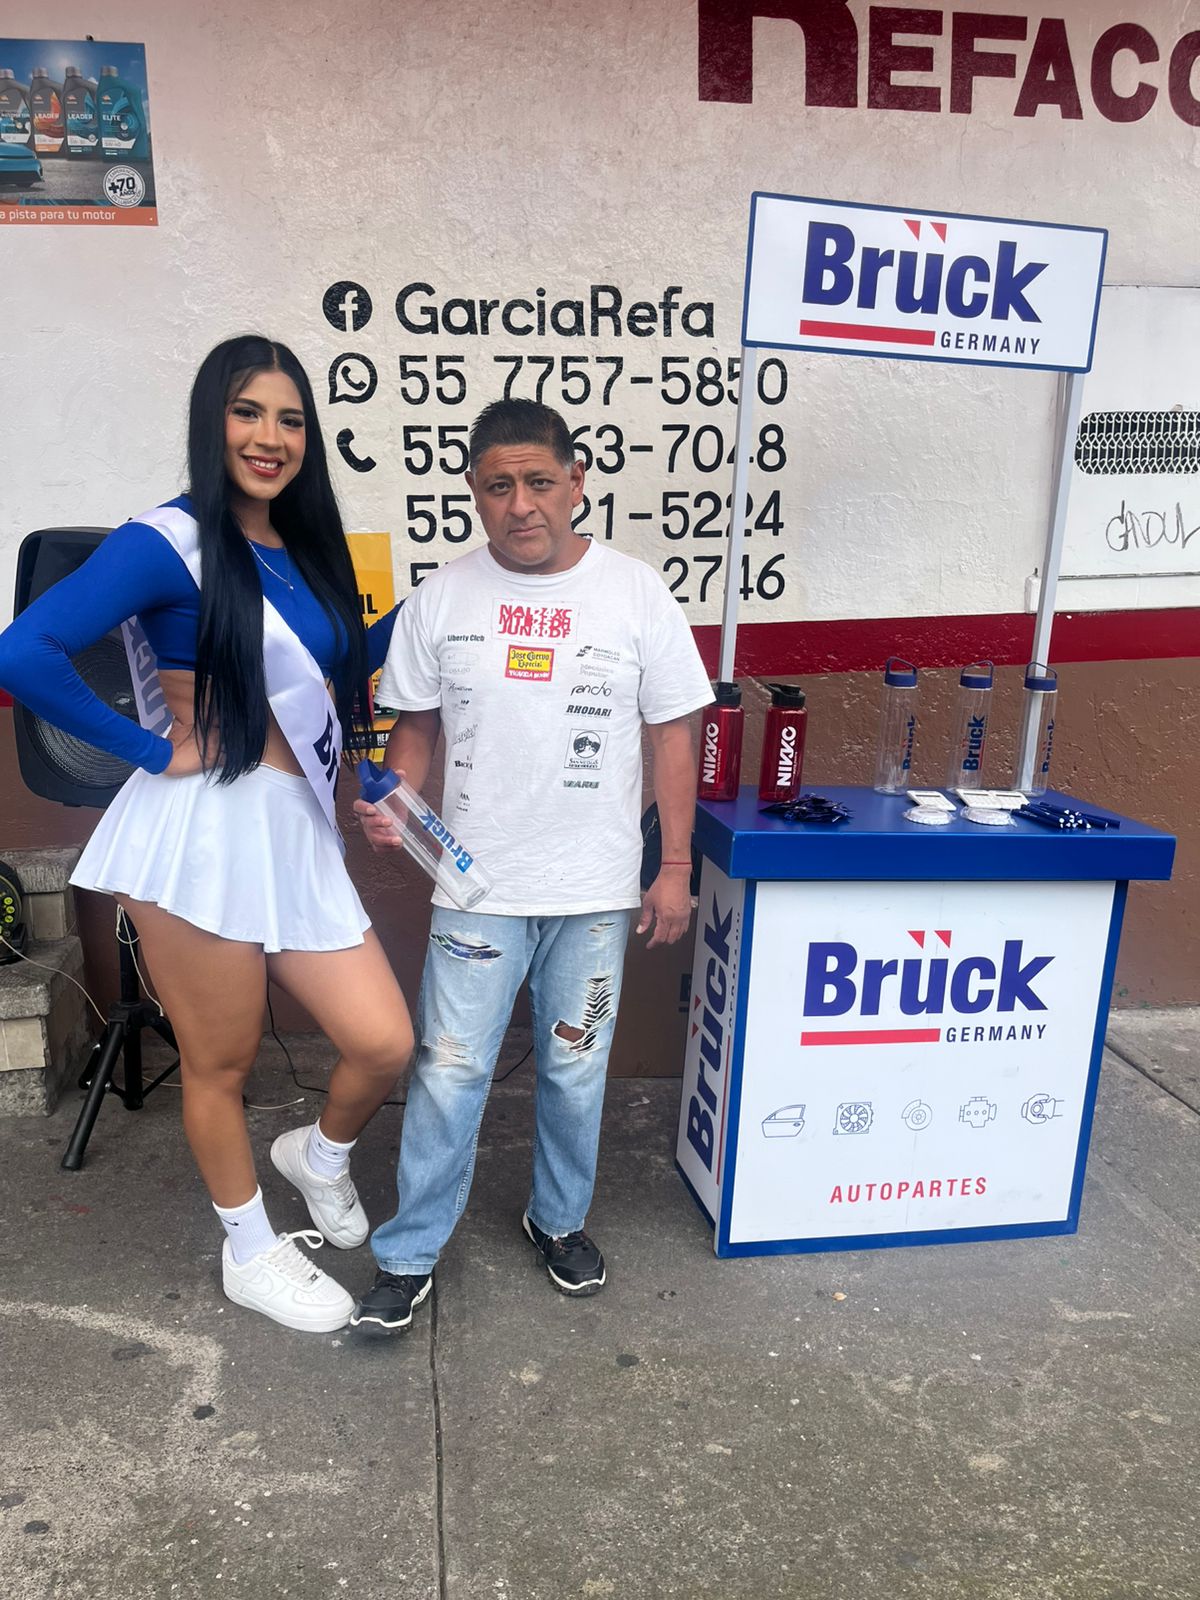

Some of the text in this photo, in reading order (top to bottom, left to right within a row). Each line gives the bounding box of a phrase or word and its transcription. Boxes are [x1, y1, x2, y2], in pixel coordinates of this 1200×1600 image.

[9, 209, 37, 222] pista
[40, 211, 64, 222] para
[67, 210, 79, 220] tu
[82, 210, 116, 220] motor
[802, 219, 1049, 323] Brück
[395, 282, 714, 337] GarciaRefa
[940, 331, 1041, 355] GERMANY
[399, 355, 467, 406] 55
[403, 423, 787, 475] 55 63-708
[407, 495, 472, 543] 55
[566, 704, 612, 717] RHODARI
[702, 722, 719, 784] NIKKO
[776, 726, 797, 786] NIKKO
[802, 930, 1056, 1017] Brück
[686, 891, 733, 1173] Brück
[945, 1024, 1047, 1043] GERMANY
[830, 1176, 987, 1204] AUTOPARTES
